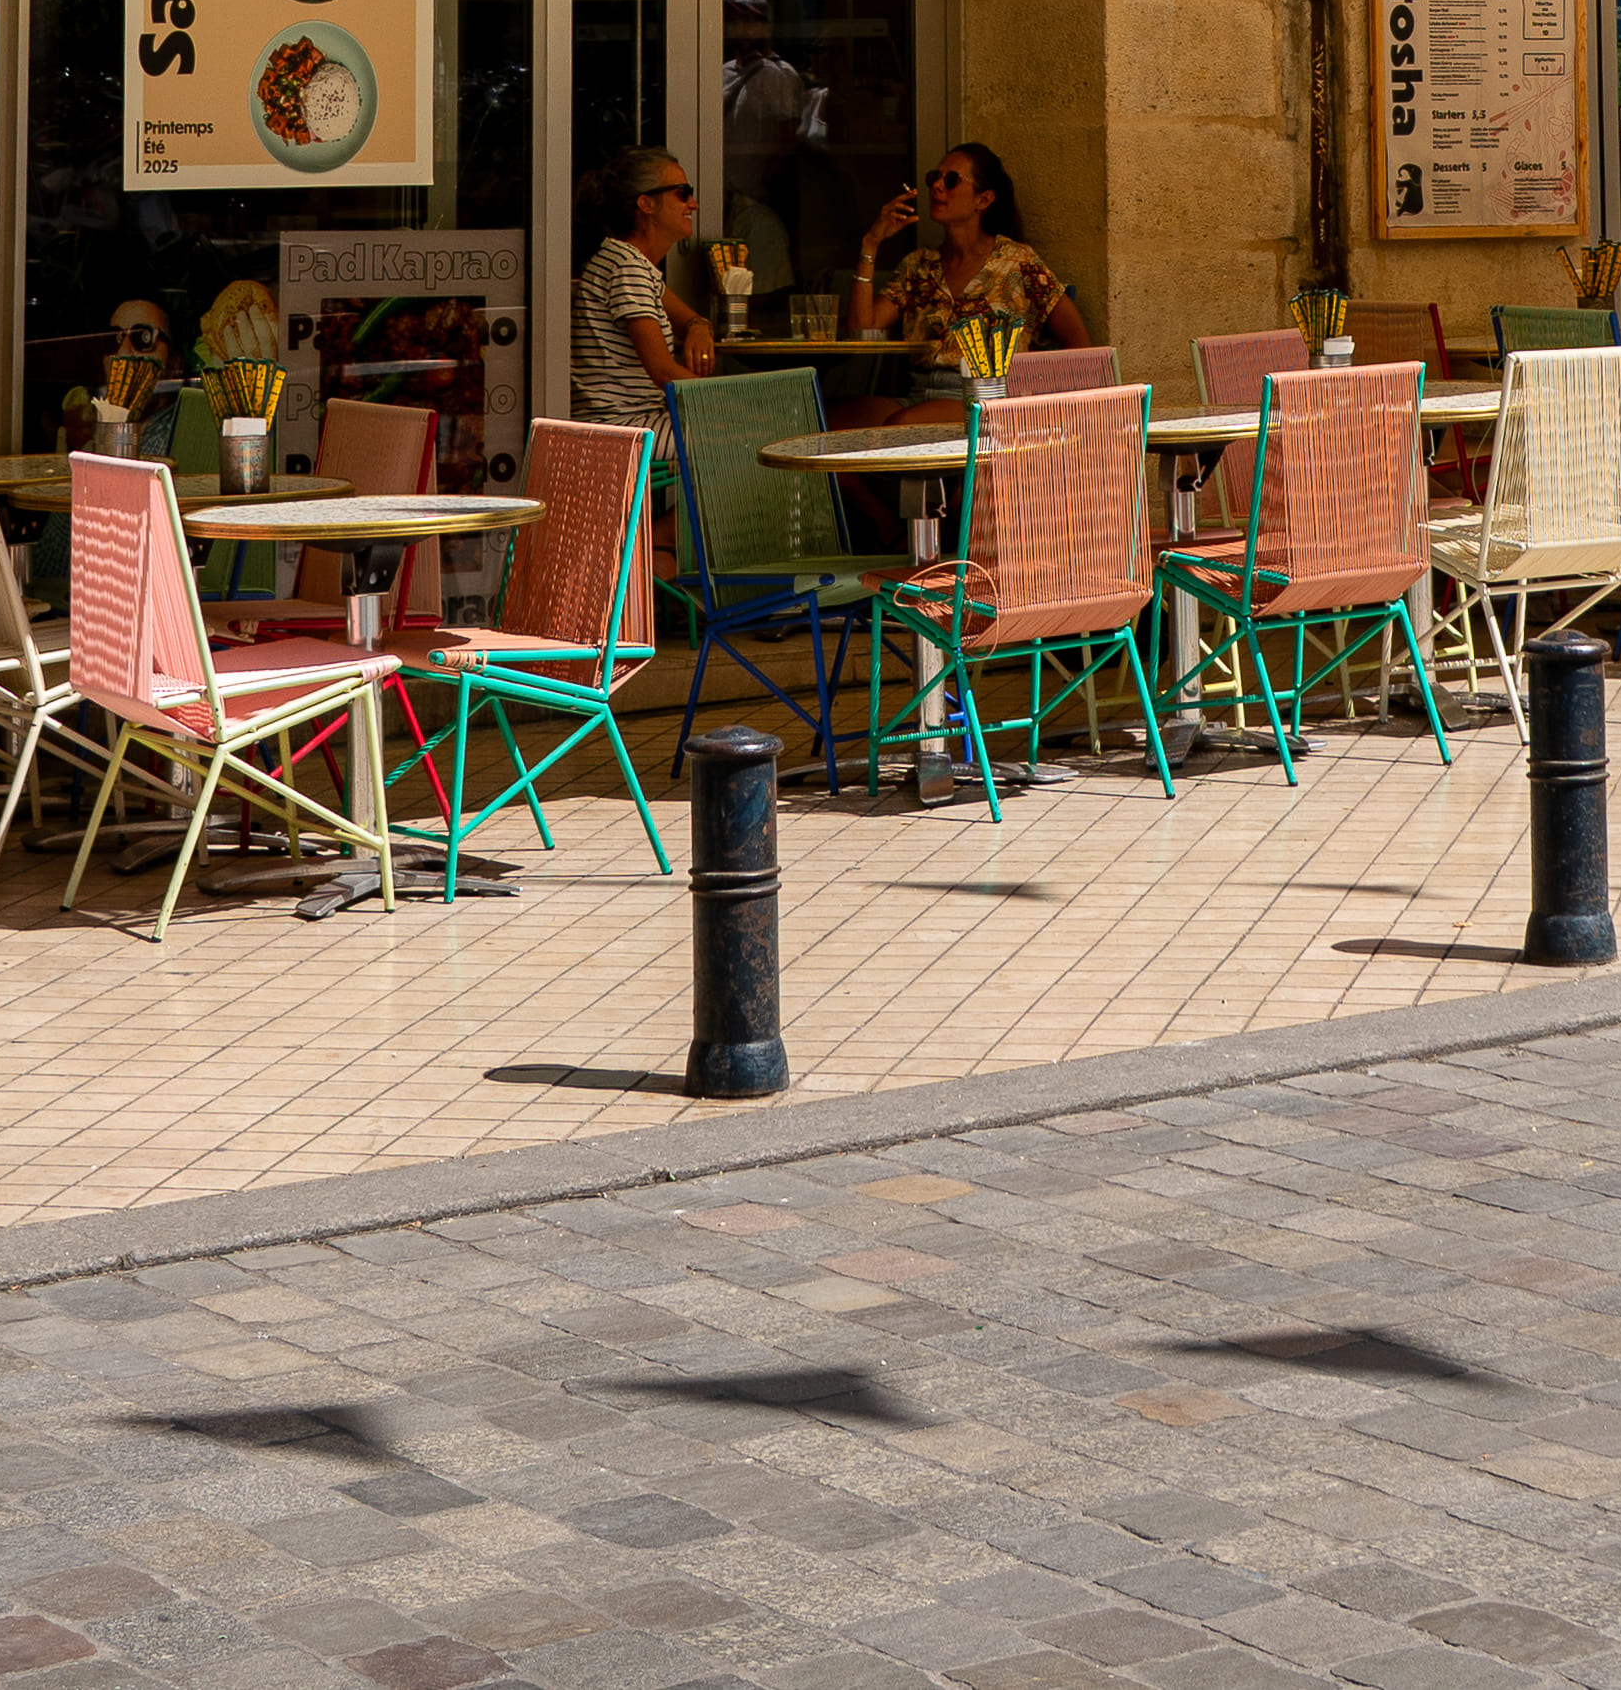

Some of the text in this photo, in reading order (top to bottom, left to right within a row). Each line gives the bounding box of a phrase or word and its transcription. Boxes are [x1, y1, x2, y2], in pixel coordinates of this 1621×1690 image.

[1432, 109, 1466, 120] Starters
[143, 120, 214, 137] Printemps
[143, 137, 165, 154] Été
[143, 159, 179, 174] 2025
[1433, 161, 1470, 172] Desserts
[1514, 161, 1543, 172] Glaces
[288, 242, 519, 291] Pad Kaprao
